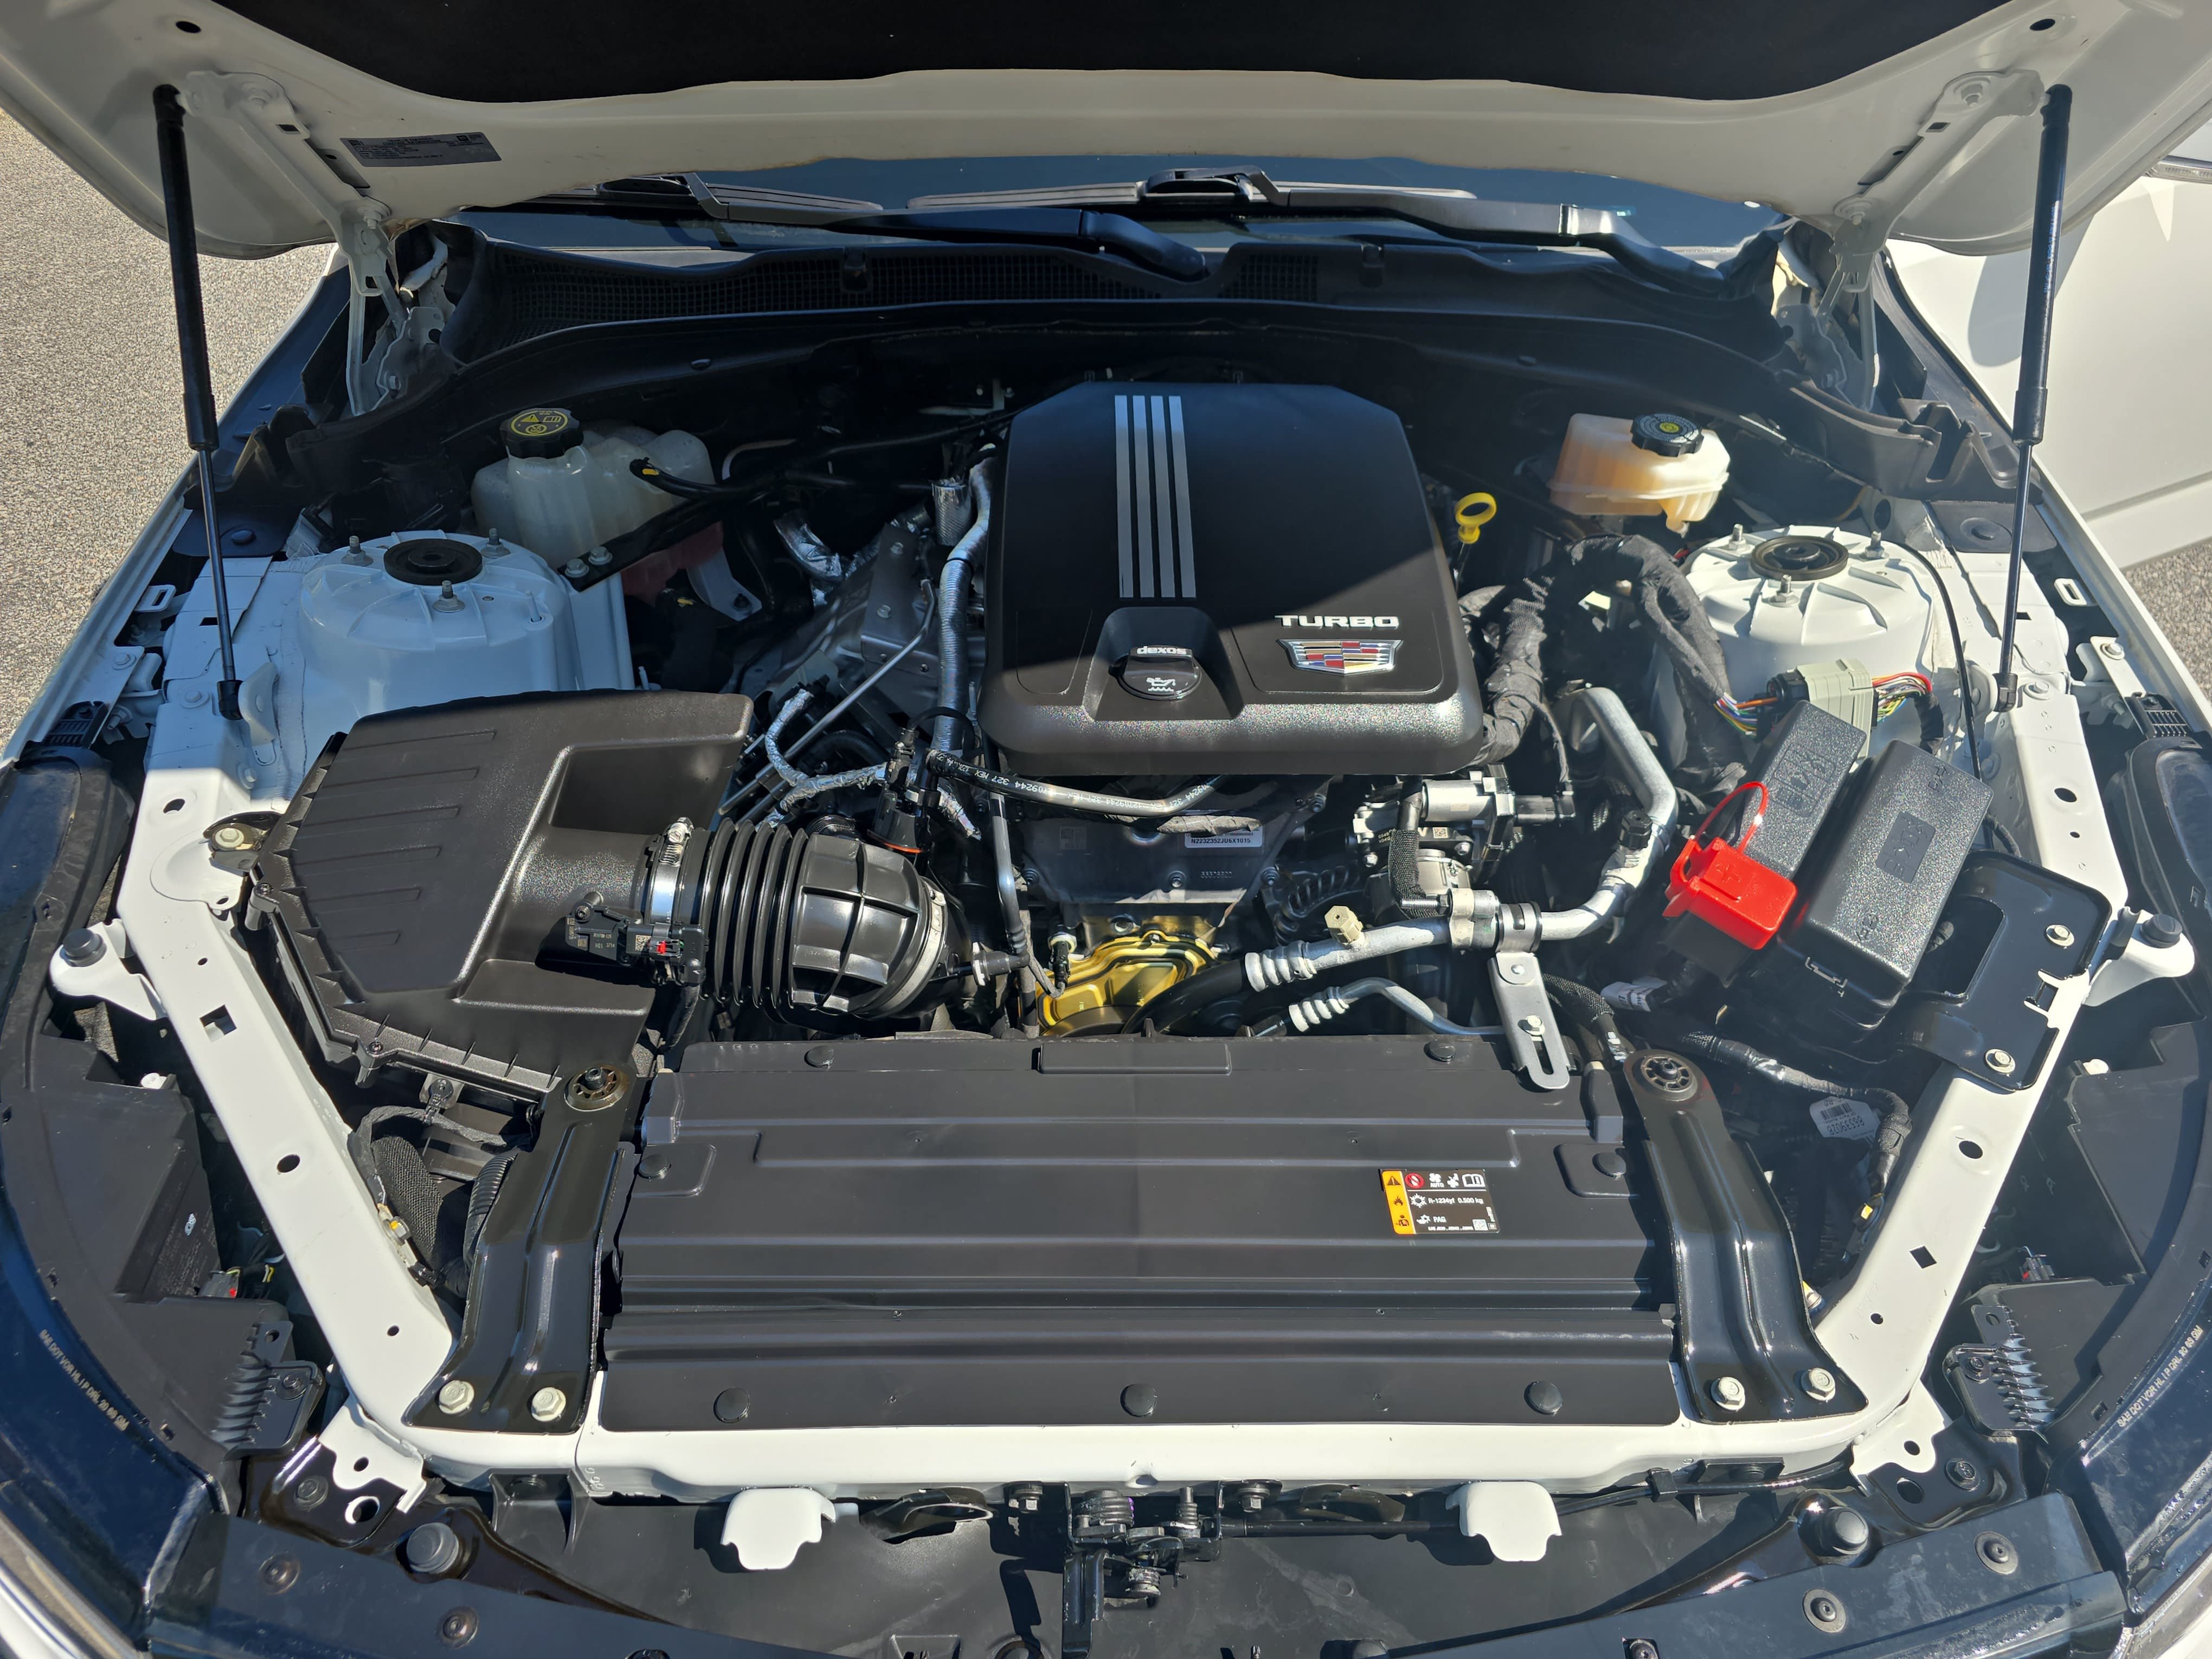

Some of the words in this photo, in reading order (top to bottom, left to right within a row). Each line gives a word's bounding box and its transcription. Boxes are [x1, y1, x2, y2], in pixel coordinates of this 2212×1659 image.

[1275, 615, 1399, 628] TURBO
[1136, 645, 1187, 655] dexos
[974, 769, 989, 779] MEX
[991, 775, 1010, 785] 327
[48, 1343, 64, 1360] DOT
[2116, 1411, 2133, 1427] SAE
[2130, 1398, 2145, 1416] DOT
[2140, 1385, 2158, 1401] VOR
[2164, 1367, 2171, 1377] P
[2168, 1355, 2183, 1371] DRL
